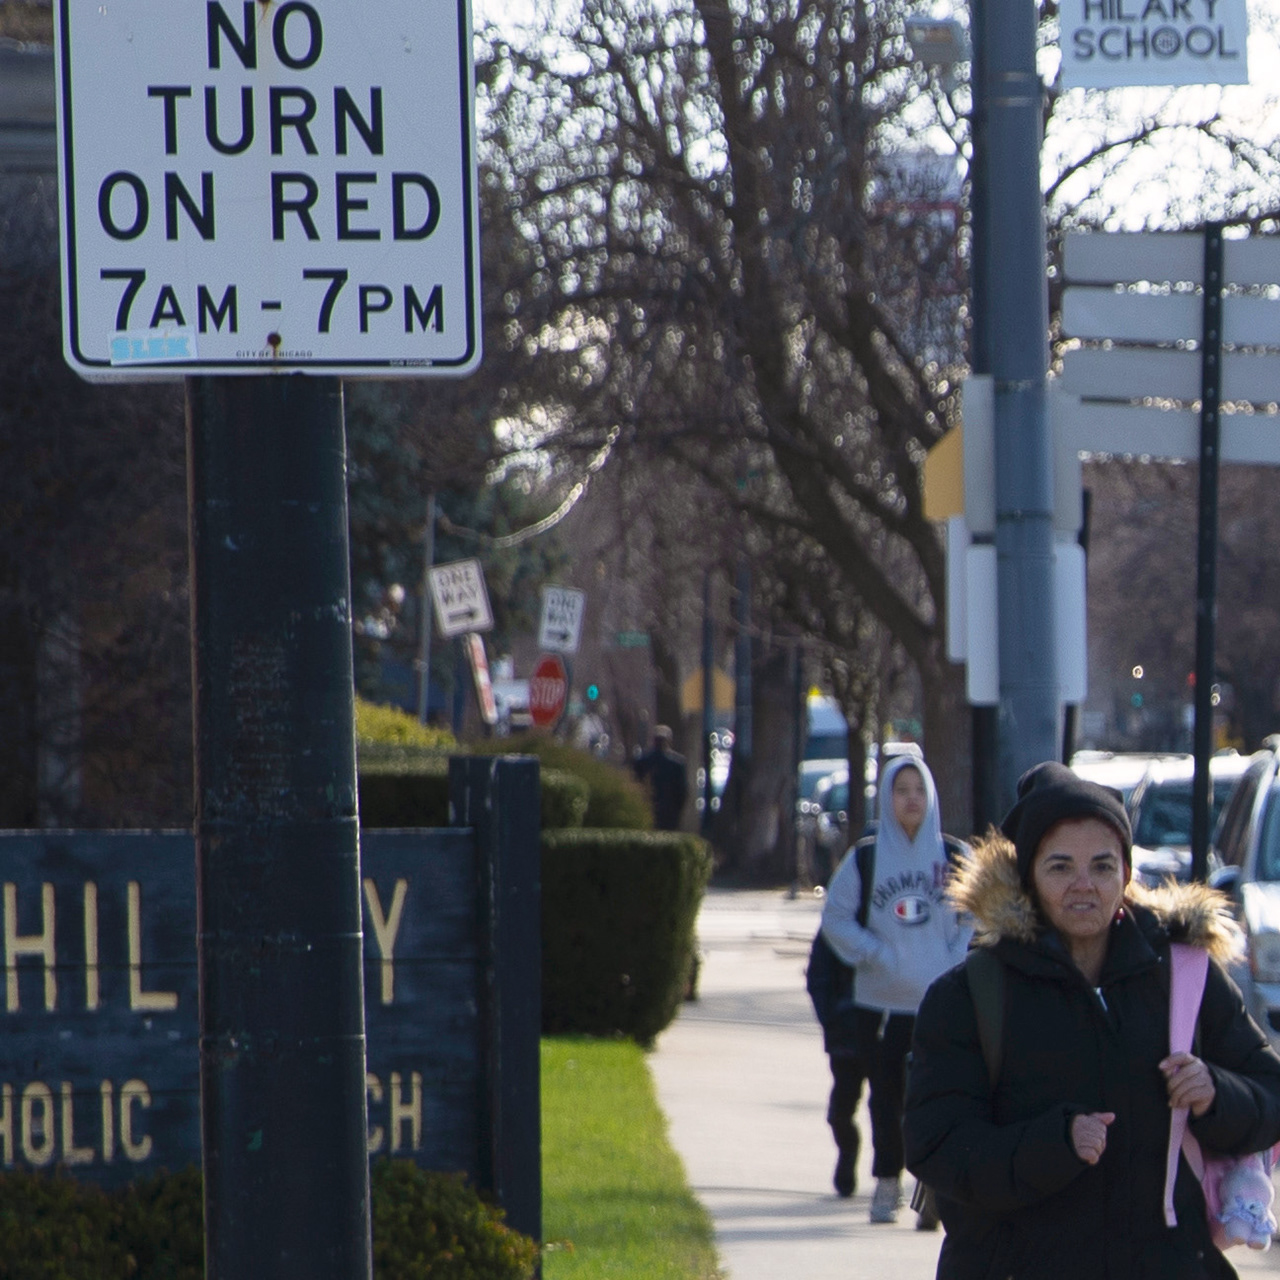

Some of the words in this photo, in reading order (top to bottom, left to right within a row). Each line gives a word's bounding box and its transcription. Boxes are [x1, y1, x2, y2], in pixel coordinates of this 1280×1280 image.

[207, 0, 324, 70] NO
[1083, 0, 1219, 22] HILARY
[1073, 26, 1240, 60] SCHOOL
[147, 86, 384, 156] TURN
[98, 171, 215, 241] ON
[272, 171, 441, 241] RED
[100, 268, 238, 334] 7AM
[303, 268, 444, 334] 7PM
[438, 567, 476, 587] ONE
[443, 582, 478, 604] WAY
[532, 677, 566, 710] STOP
[3, 878, 408, 1013] HILY
